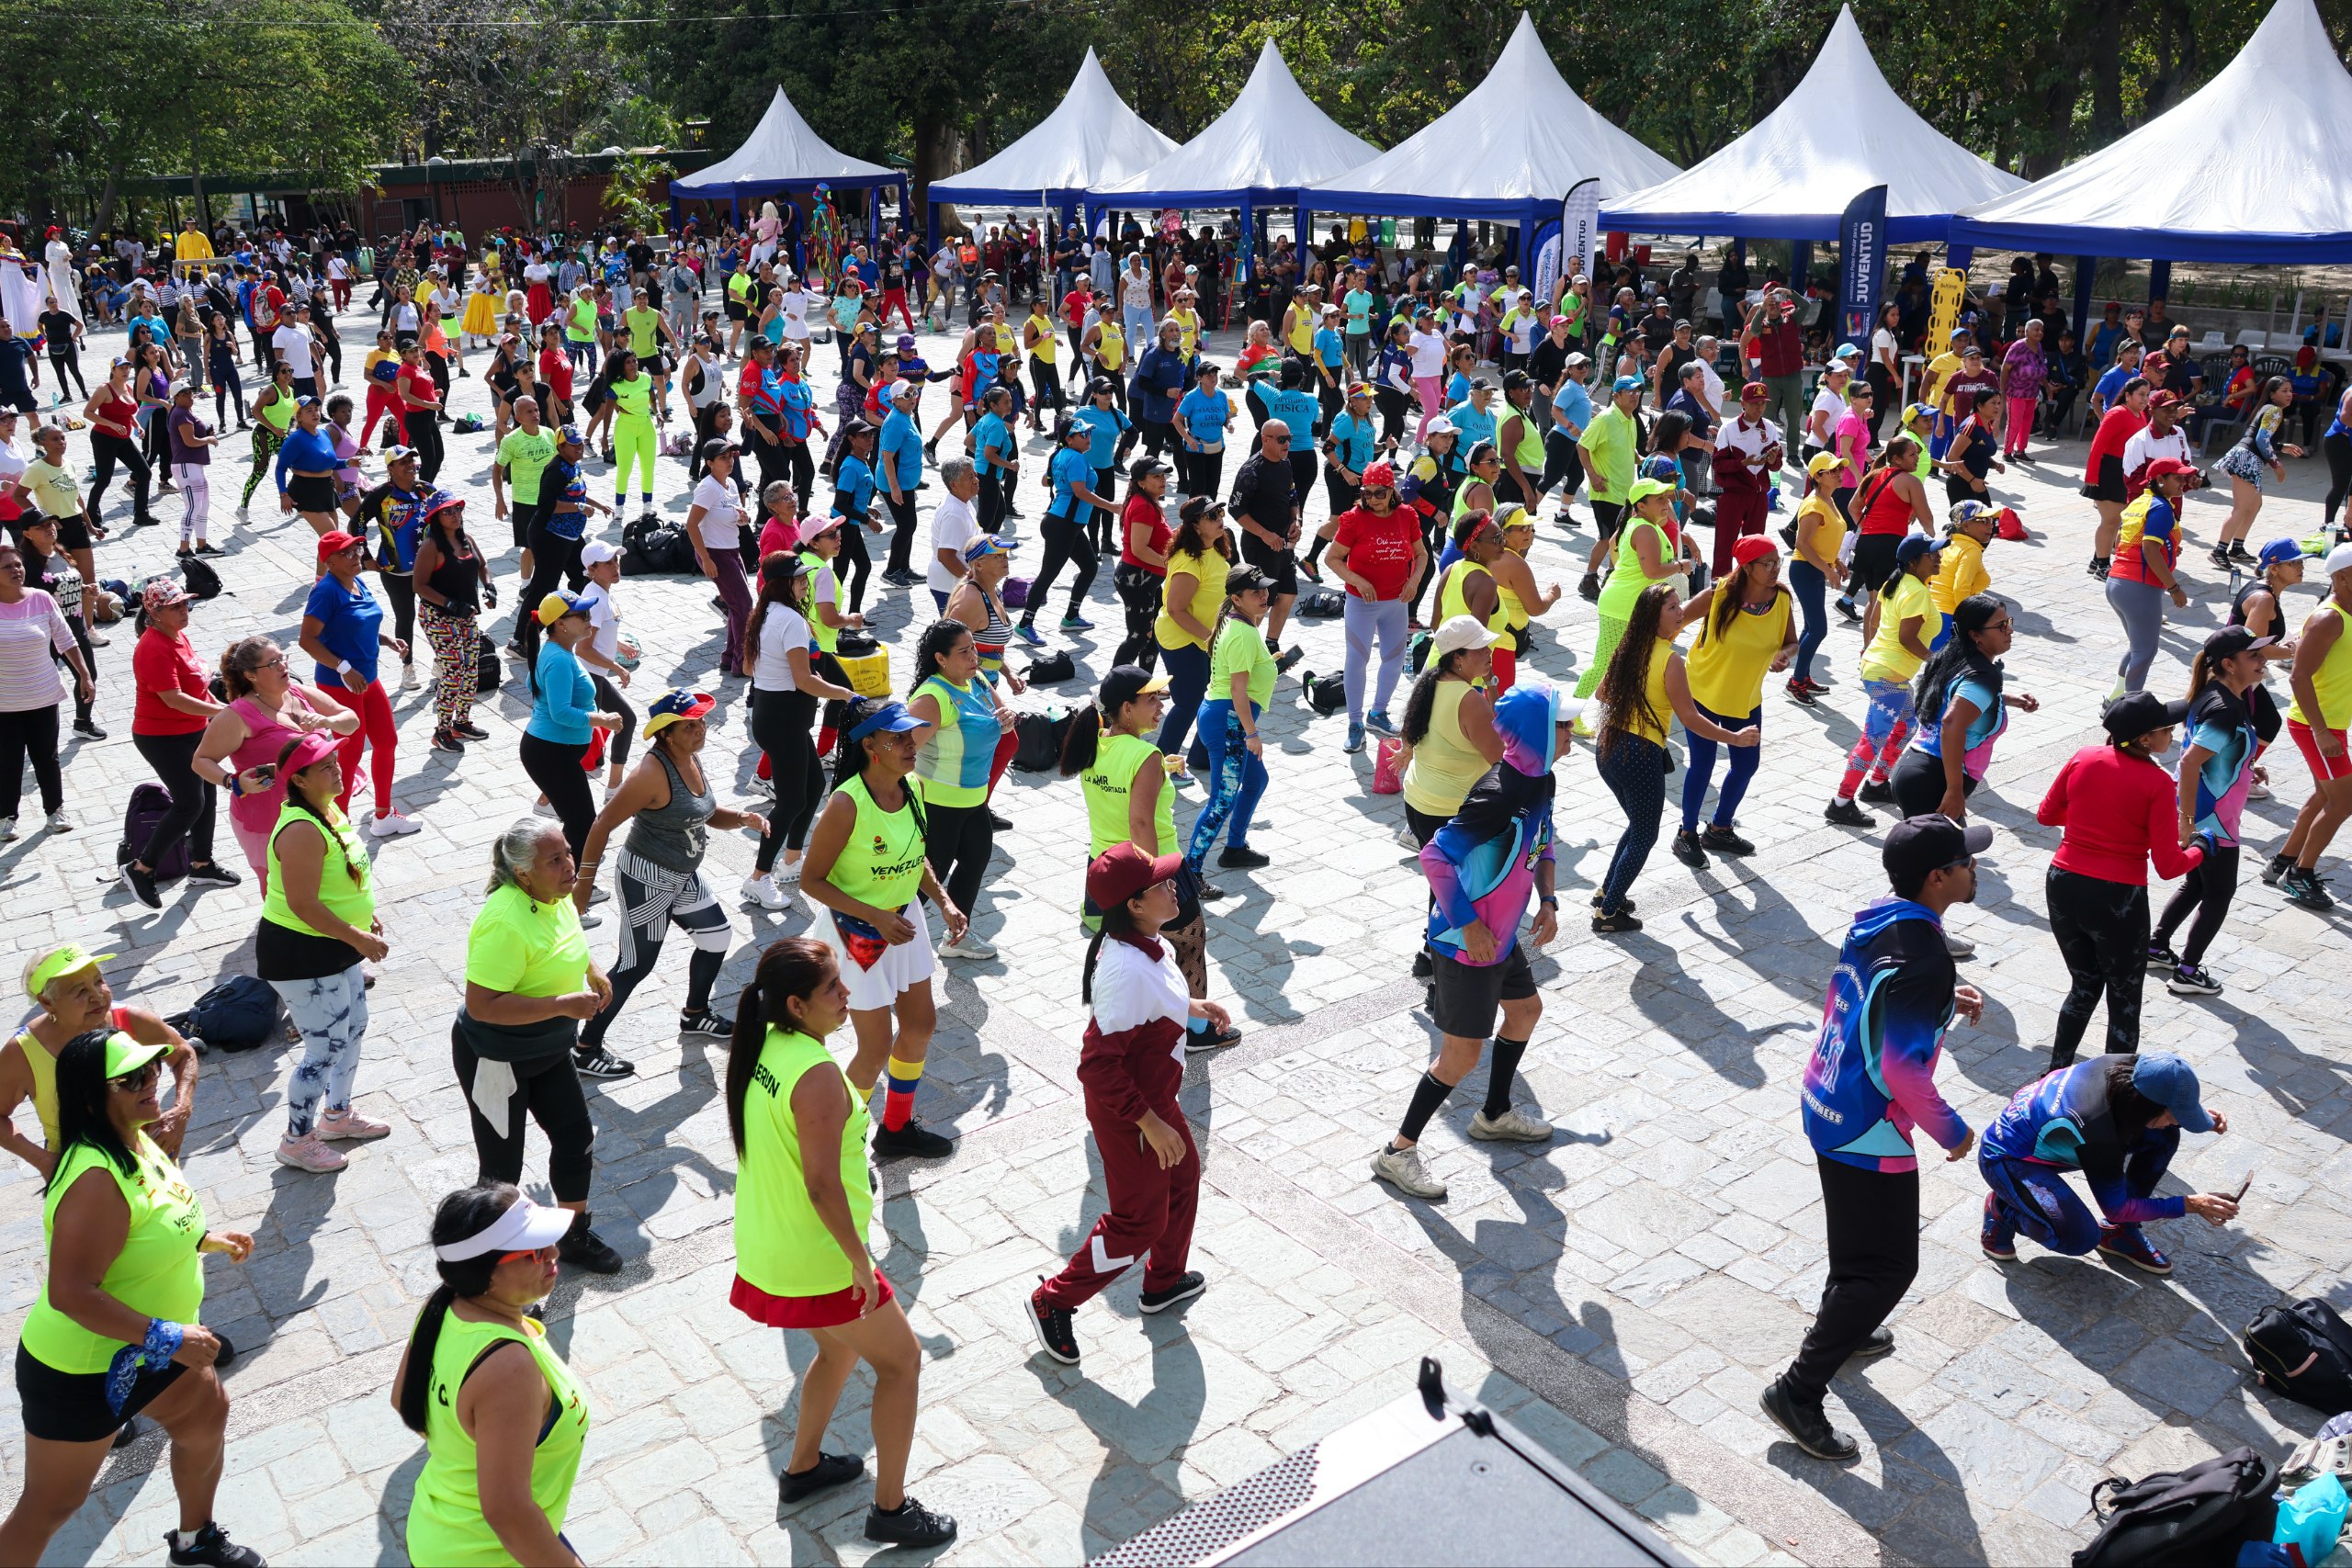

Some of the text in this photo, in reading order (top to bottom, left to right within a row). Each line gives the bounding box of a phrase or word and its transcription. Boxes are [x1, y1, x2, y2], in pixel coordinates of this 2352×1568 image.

[1857, 221, 1872, 303] JUVENTUD
[1274, 404, 1309, 412] FISICA
[1472, 423, 1492, 431] OASIS
[870, 854, 926, 876] VENEZUEL
